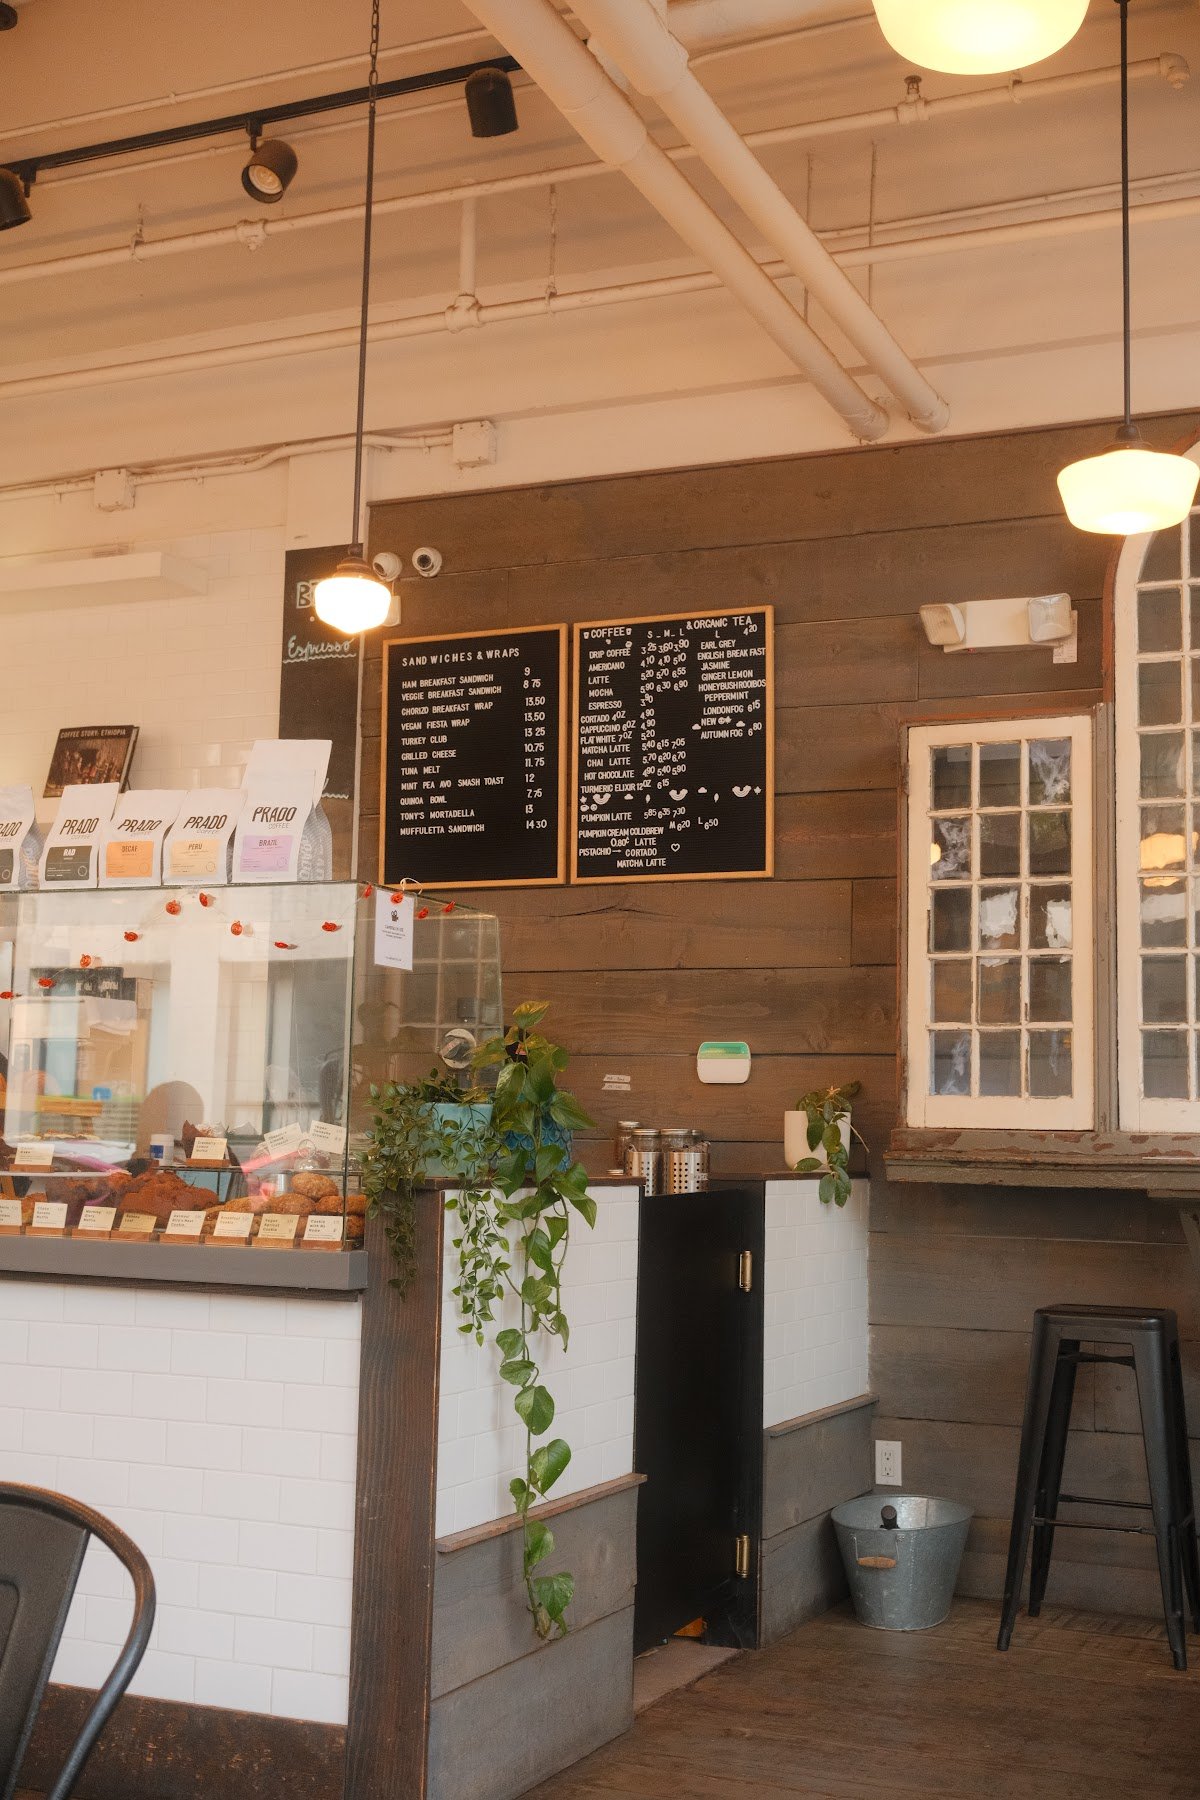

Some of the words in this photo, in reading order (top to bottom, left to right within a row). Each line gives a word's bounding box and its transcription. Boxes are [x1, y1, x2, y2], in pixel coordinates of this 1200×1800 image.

[694, 618, 728, 629] ORGANIC
[732, 616, 752, 626] TEA
[591, 627, 625, 638] COFFEE
[715, 630, 720, 638] L
[288, 635, 354, 662] Espresso
[701, 641, 717, 650] EARL
[719, 640, 736, 648] GREY
[477, 651, 483, 660] &
[486, 648, 519, 659] WRAPS
[589, 650, 605, 659] DRIP
[606, 648, 631, 657] COFFEE
[698, 651, 725, 660] ENGLISH
[589, 662, 625, 672] AMERICANO
[701, 661, 730, 671] JASMINE
[402, 680, 417, 689] HAM
[420, 677, 456, 688] BREAKFAST
[460, 674, 494, 684] SANDWICH
[525, 667, 530, 676] 9
[588, 676, 610, 685] LATTE
[702, 672, 726, 681] GINGER
[728, 670, 754, 679] LEMON
[402, 692, 424, 701] VEGGIE
[428, 689, 465, 699] BREAKFAST
[468, 686, 502, 696] SANDWICH
[589, 688, 614, 697] MOCHA
[705, 691, 749, 702] PEPPERMINT
[401, 706, 429, 716] CHORIZO
[432, 703, 470, 714] BREAKFAST
[474, 702, 494, 710] WRAP
[525, 696, 546, 706] 13.50
[589, 700, 622, 710] ESPRESSO
[401, 722, 422, 731] VEGAN
[427, 720, 448, 729] FIESTA
[451, 719, 470, 727] WRAP
[524, 712, 545, 721] 13.50
[581, 714, 610, 724] CORTADO
[701, 718, 717, 726] NEW
[61, 730, 79, 738] COFFEE
[581, 724, 620, 734] CAPPUCCINO
[701, 730, 729, 740] AUTUMN
[730, 729, 743, 738] FOG
[401, 737, 426, 746] TURKEY
[430, 735, 447, 744] CLUB
[401, 752, 428, 761] GRILLED
[432, 750, 457, 759] CHEESE
[524, 743, 544, 752] 10.75
[582, 746, 608, 754] MATCHA
[610, 744, 630, 753] LATTE
[587, 759, 603, 768] CHAI
[609, 757, 631, 766] LATTE
[401, 767, 418, 776] TUNA
[423, 766, 440, 774] MELT
[584, 772, 597, 781] HOT
[598, 770, 635, 780] CHOCOLATE
[401, 782, 418, 790] MINT
[423, 781, 435, 789] PEA
[440, 780, 452, 788] AVO
[458, 778, 480, 787] SMASH
[484, 777, 505, 786] TOAST
[525, 774, 535, 782] 12
[581, 784, 613, 794] TURMERIC
[615, 783, 635, 792] ELIXIR
[400, 797, 424, 806] QUINOA
[430, 796, 447, 804] BOWL
[252, 807, 297, 822] PRADO
[401, 812, 425, 820] TONY'S
[430, 809, 475, 819] MORTADELLA
[526, 804, 534, 814] 13
[581, 813, 610, 822] PUMPKIN
[611, 812, 632, 821] LATTE
[60, 818, 99, 835] PRADO
[118, 819, 162, 832] PRADO
[183, 815, 227, 830] PRADO
[400, 826, 445, 836] MUFFULETTA
[448, 824, 485, 833] SANDWICH
[579, 829, 607, 838] PUMPKIN
[607, 828, 629, 838] CREAM
[669, 821, 676, 829] M
[635, 838, 657, 846] LATTE
[625, 848, 658, 857] CORTADO
[617, 860, 643, 868] MATCHA
[646, 858, 666, 867] LATTE
